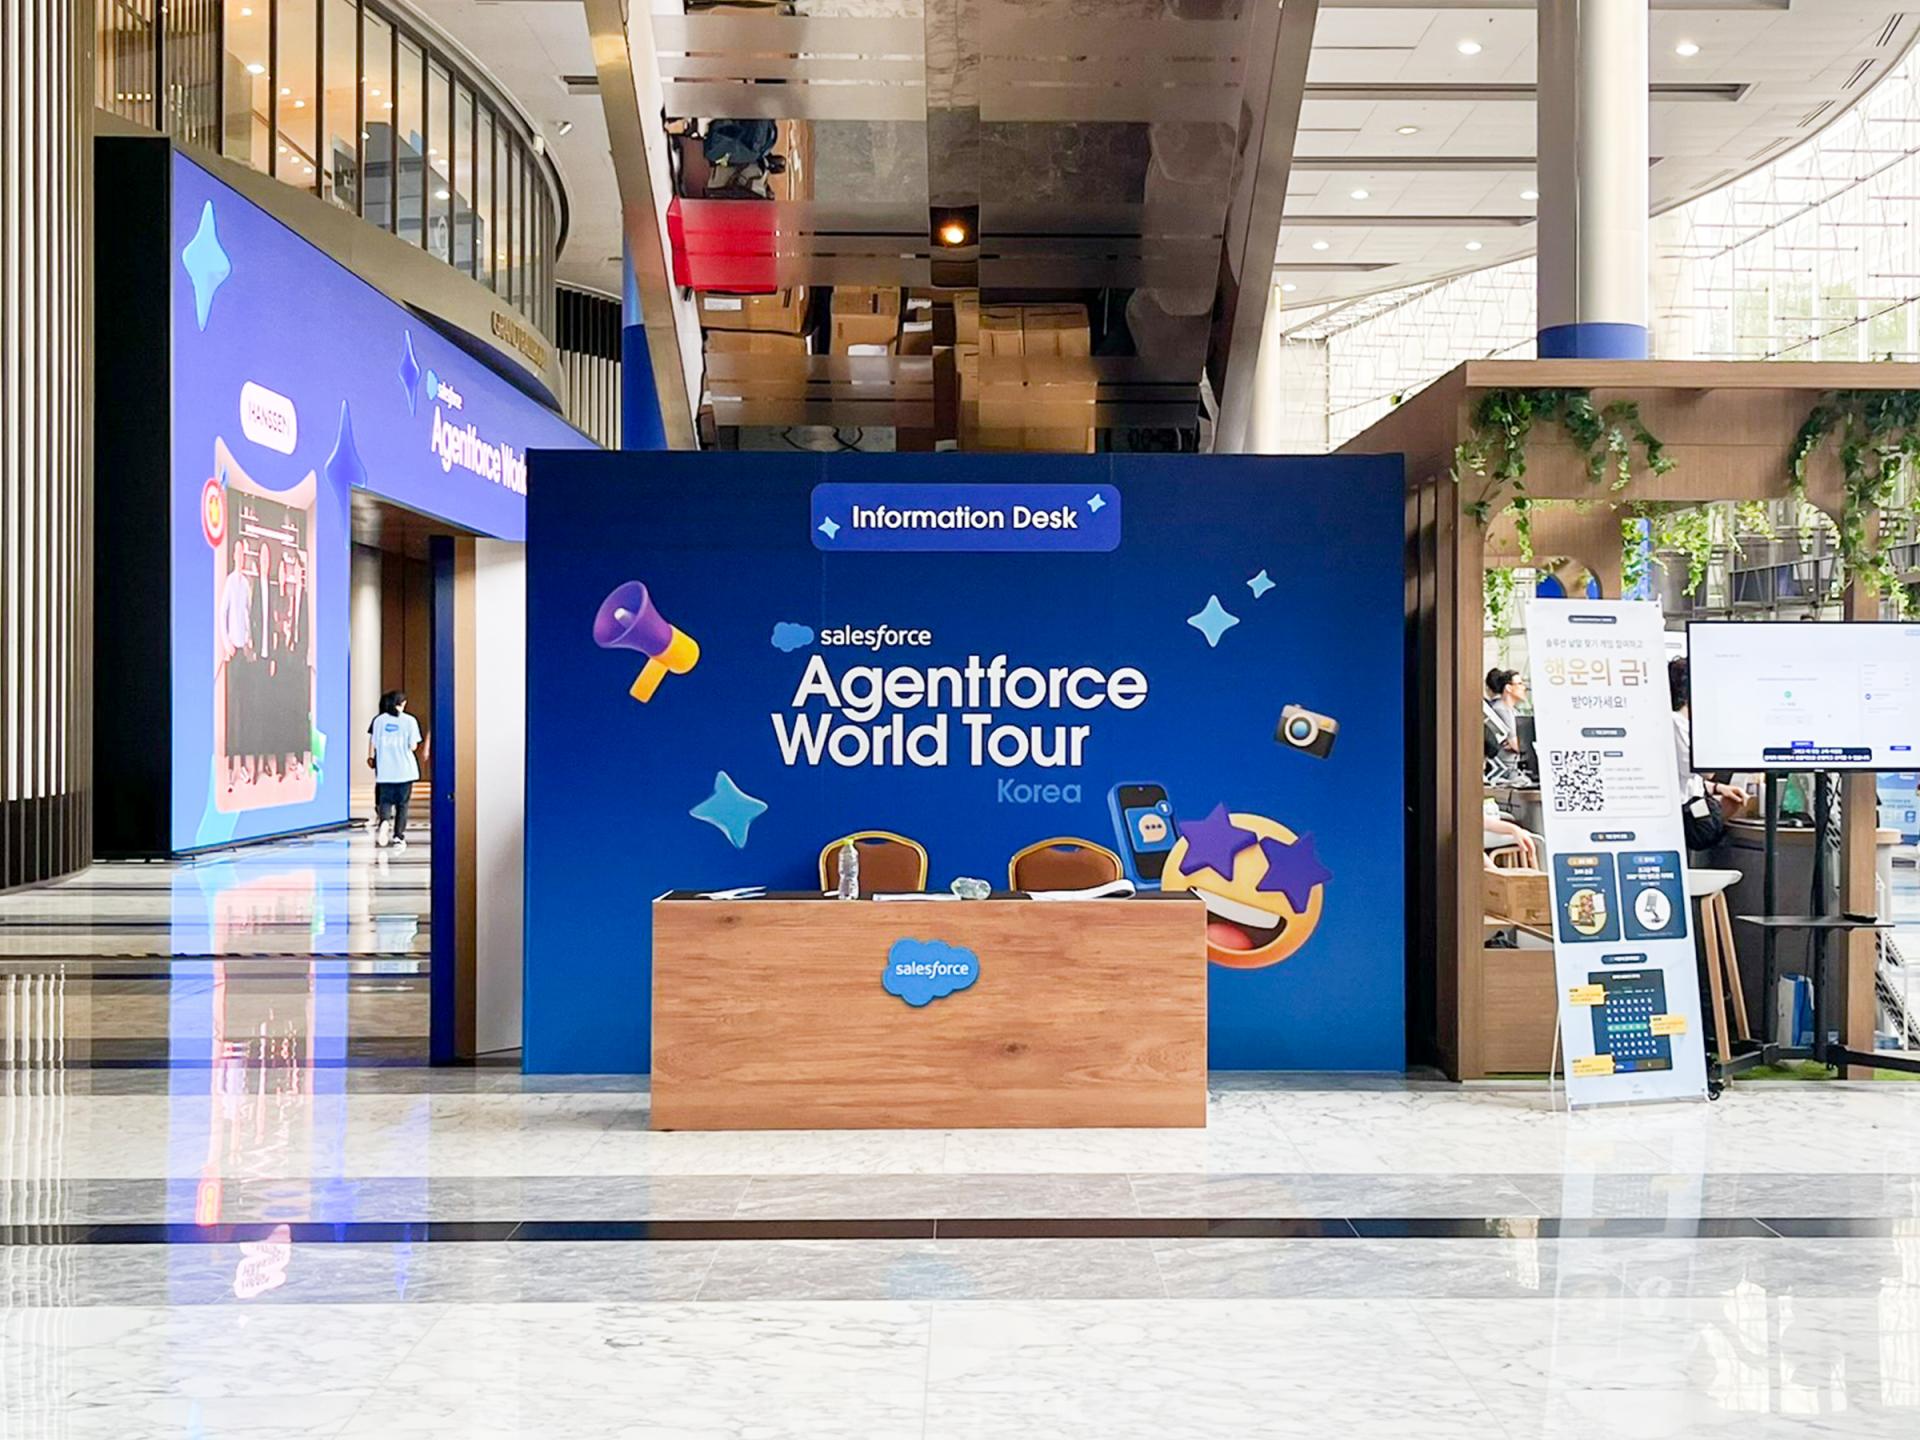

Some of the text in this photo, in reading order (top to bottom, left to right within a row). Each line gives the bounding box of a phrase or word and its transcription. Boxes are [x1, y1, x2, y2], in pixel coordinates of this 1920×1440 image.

[431, 406, 501, 484] Agentforce
[851, 505, 1078, 529] Information Desk
[820, 624, 932, 651] salesforce
[1544, 656, 1649, 687] 행운의 금!
[791, 653, 1149, 722] Agentforce
[1570, 695, 1628, 709] 받아가세요!
[771, 712, 1090, 767] World Tour
[997, 778, 1082, 804] Korea
[895, 960, 969, 979] salesforce
